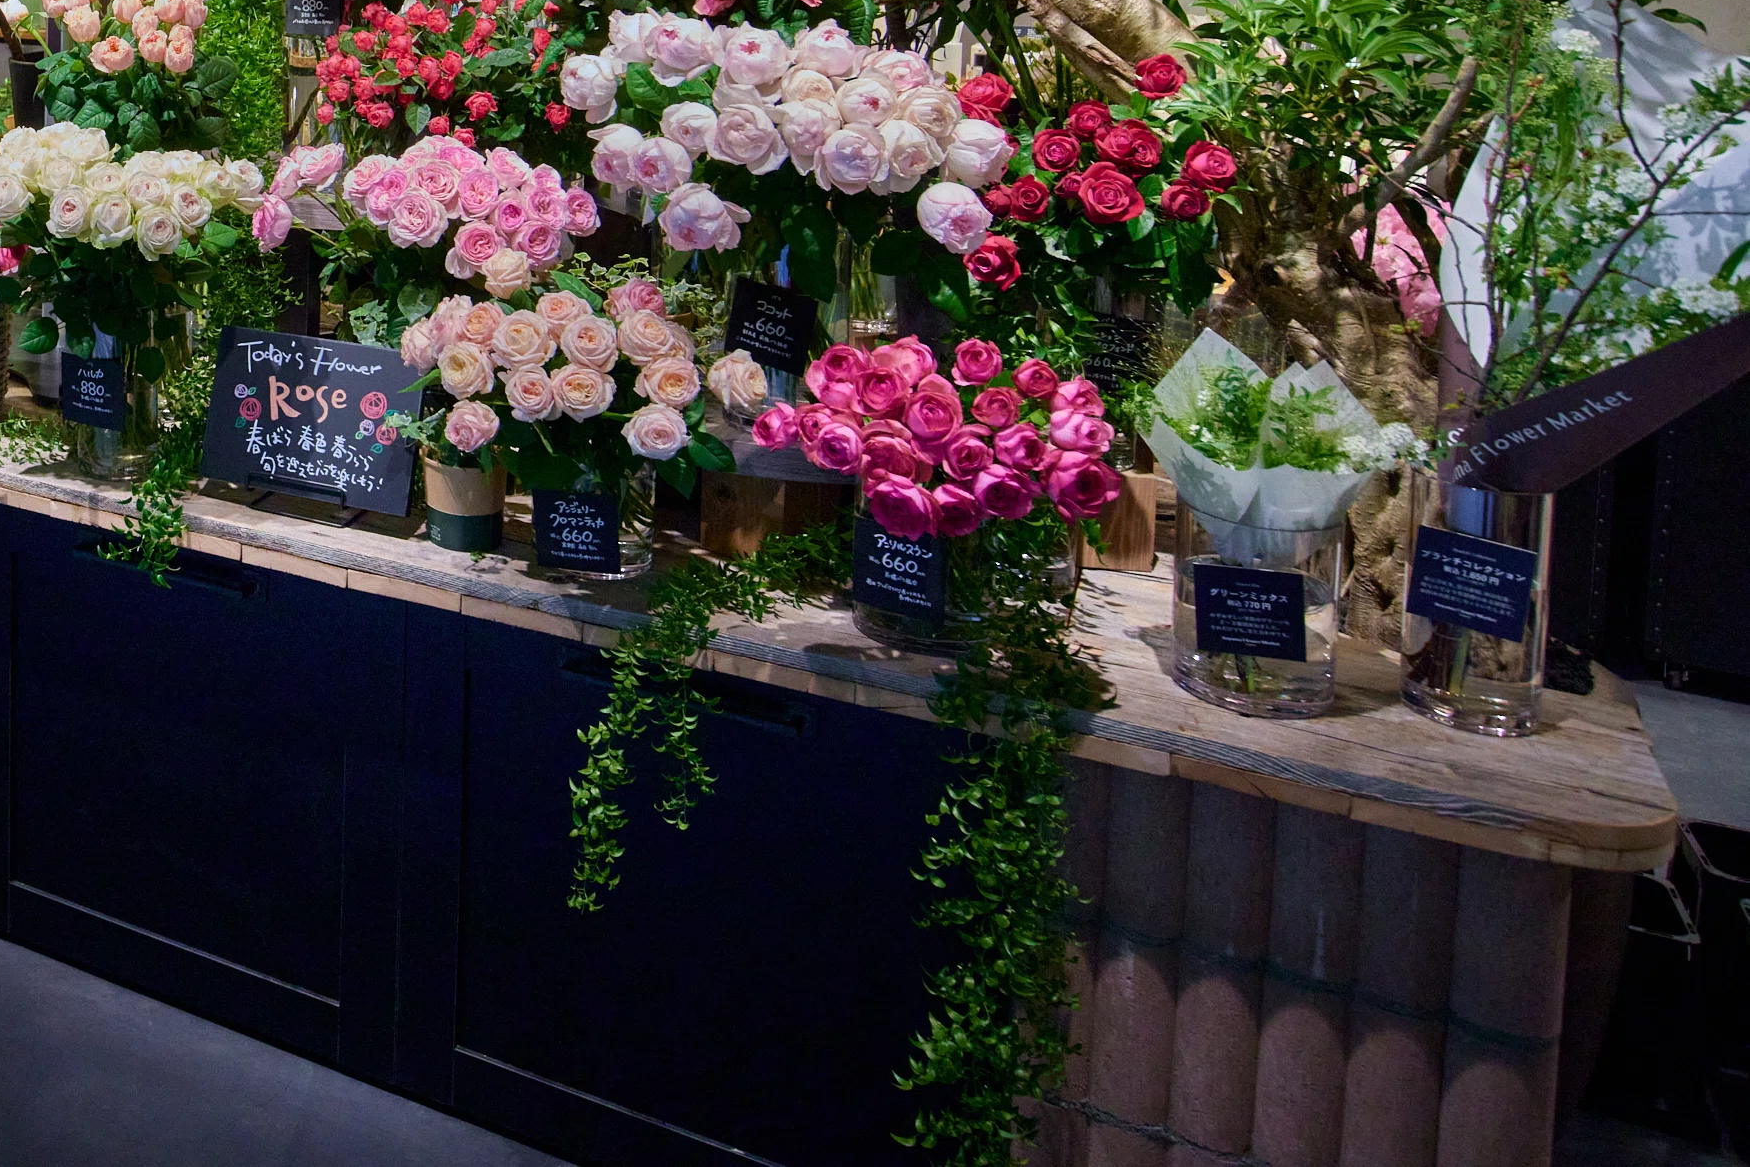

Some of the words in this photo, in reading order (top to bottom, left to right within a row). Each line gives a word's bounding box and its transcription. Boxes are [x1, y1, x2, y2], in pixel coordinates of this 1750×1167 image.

[302, 0, 323, 12] 880
[755, 317, 786, 337] 660
[80, 380, 105, 396] 880
[268, 375, 348, 424] Rose
[1469, 423, 1548, 465] Flower
[1545, 390, 1633, 431] Market
[561, 527, 593, 543] 660
[881, 552, 919, 574] 660
